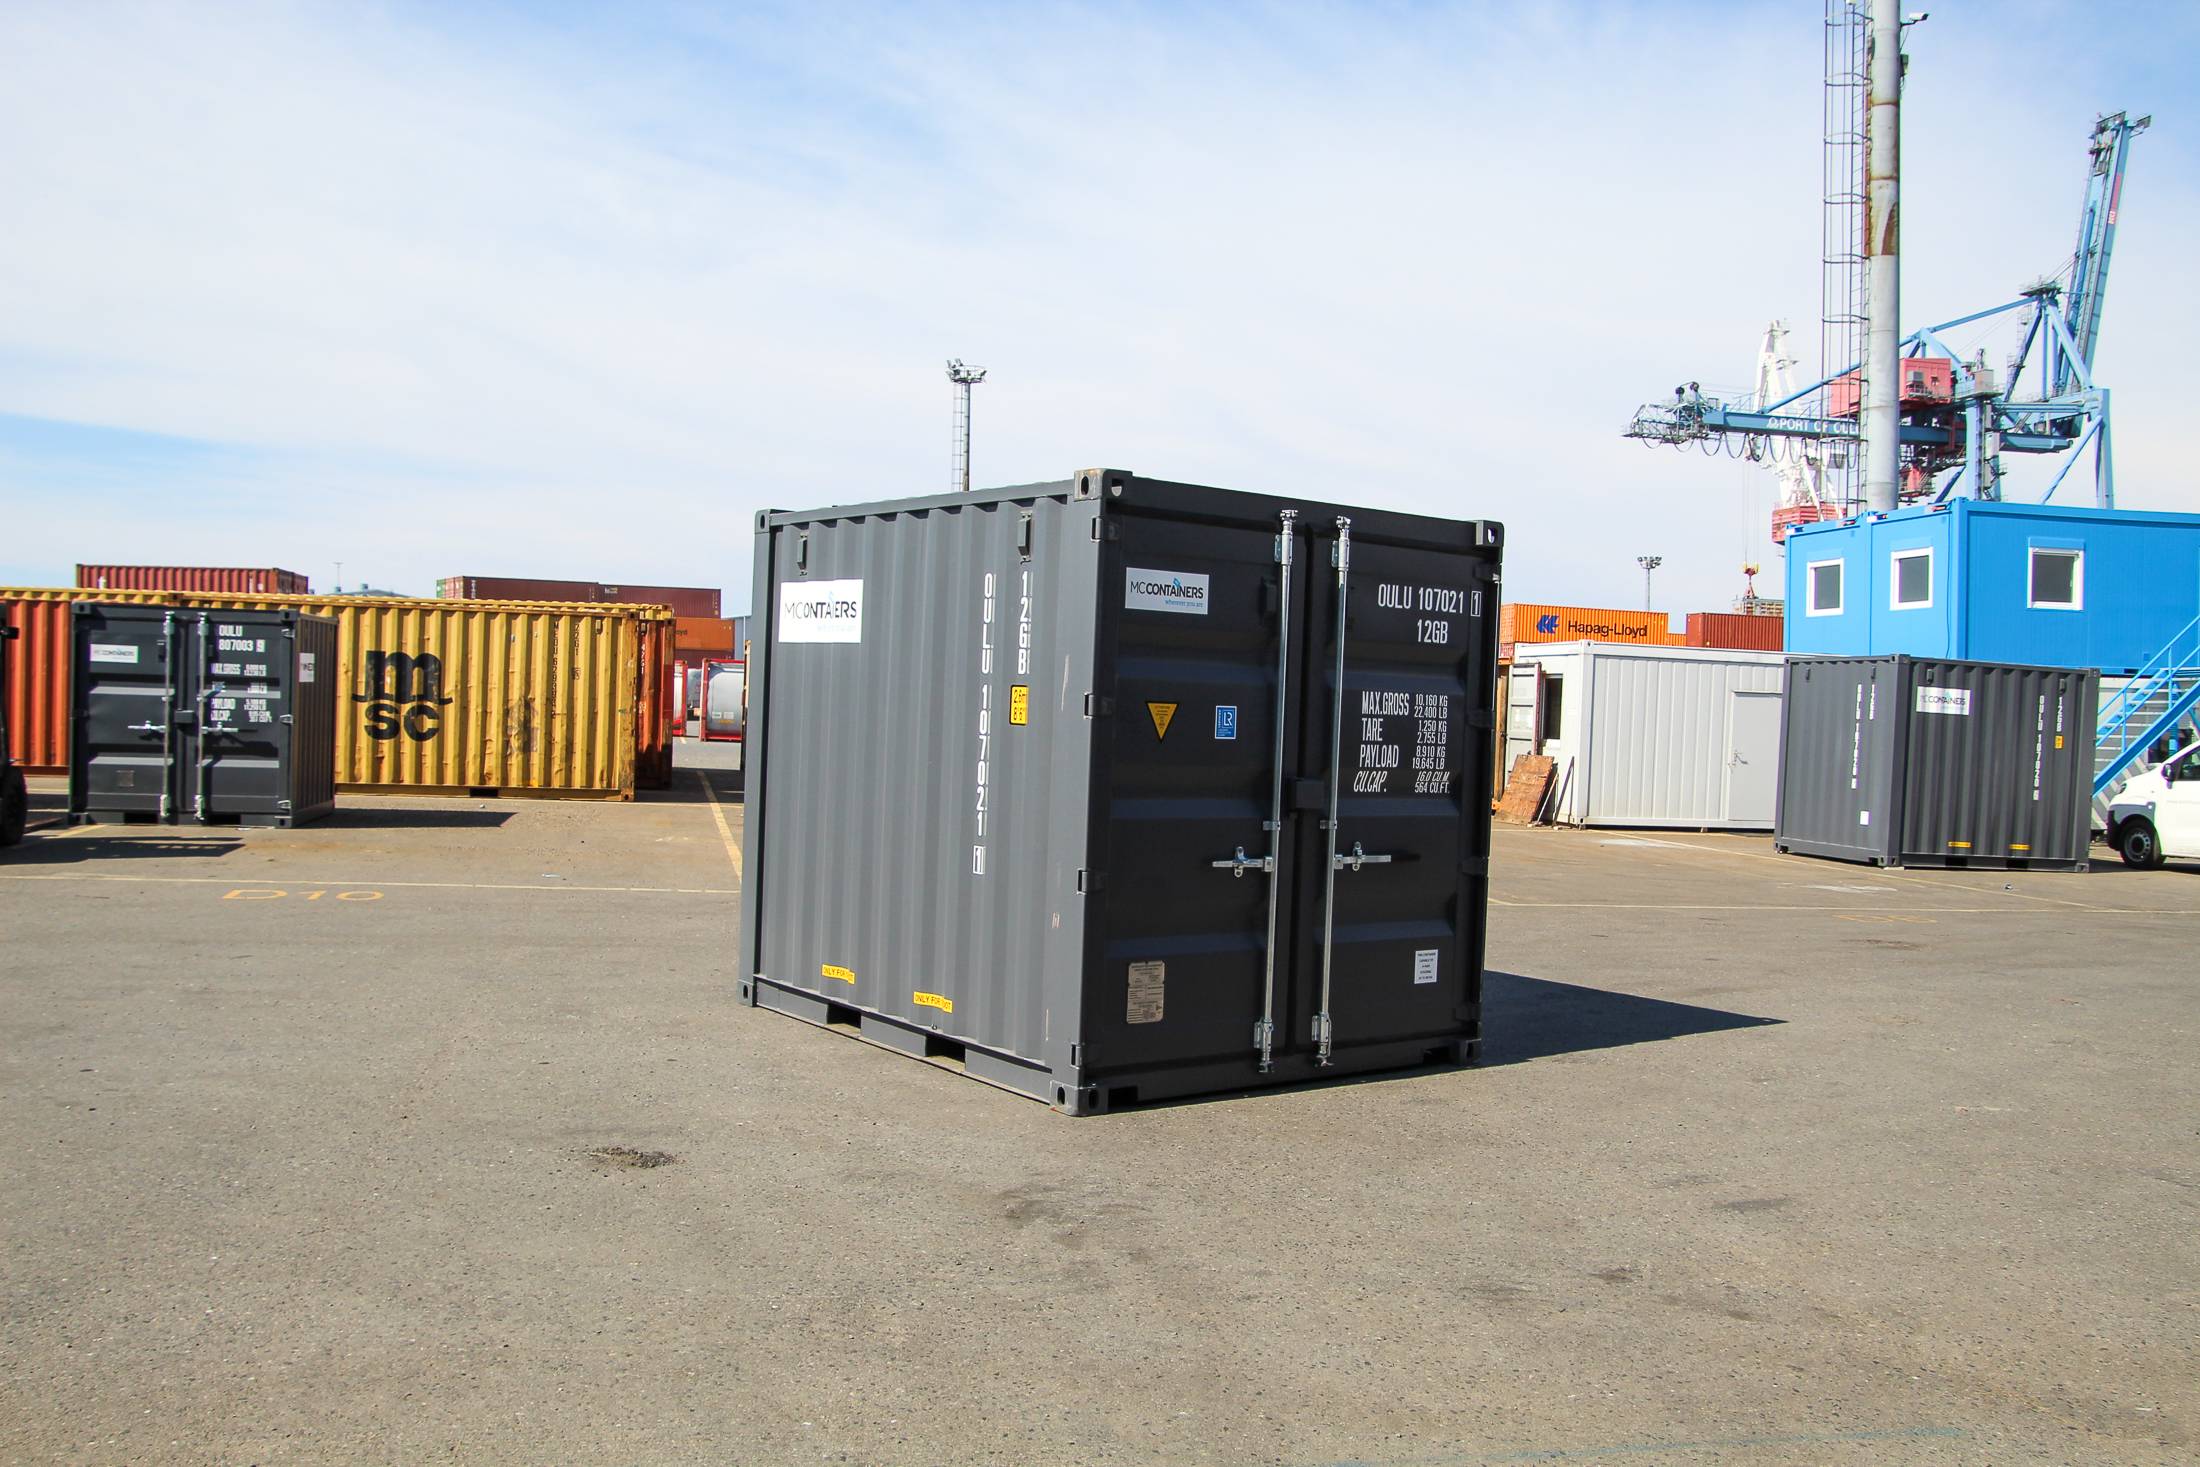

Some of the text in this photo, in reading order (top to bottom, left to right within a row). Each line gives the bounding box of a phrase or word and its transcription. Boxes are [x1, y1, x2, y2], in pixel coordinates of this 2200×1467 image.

[1780, 418, 1810, 431] PORT
[1378, 584, 1481, 616] OULU 107021 1
[1018, 571, 1033, 675] 12GB
[1417, 619, 1449, 644] 12GB
[1568, 620, 1648, 639] Hapag-Lloyd
[1361, 691, 1448, 716] MAX.GROSS 10.160 KG
[1414, 706, 1448, 719] 22.400 LB
[973, 573, 997, 875] OULU 107021 1
[1361, 717, 1447, 741] TARE 1.250 KG
[1417, 731, 1447, 744] 2.755 LB
[1359, 744, 1446, 768] PAYLOAD 8.910 KG
[1412, 757, 1445, 769] 19.645 LB
[1414, 781, 1428, 793] 564
[222, 889, 385, 900] D10
